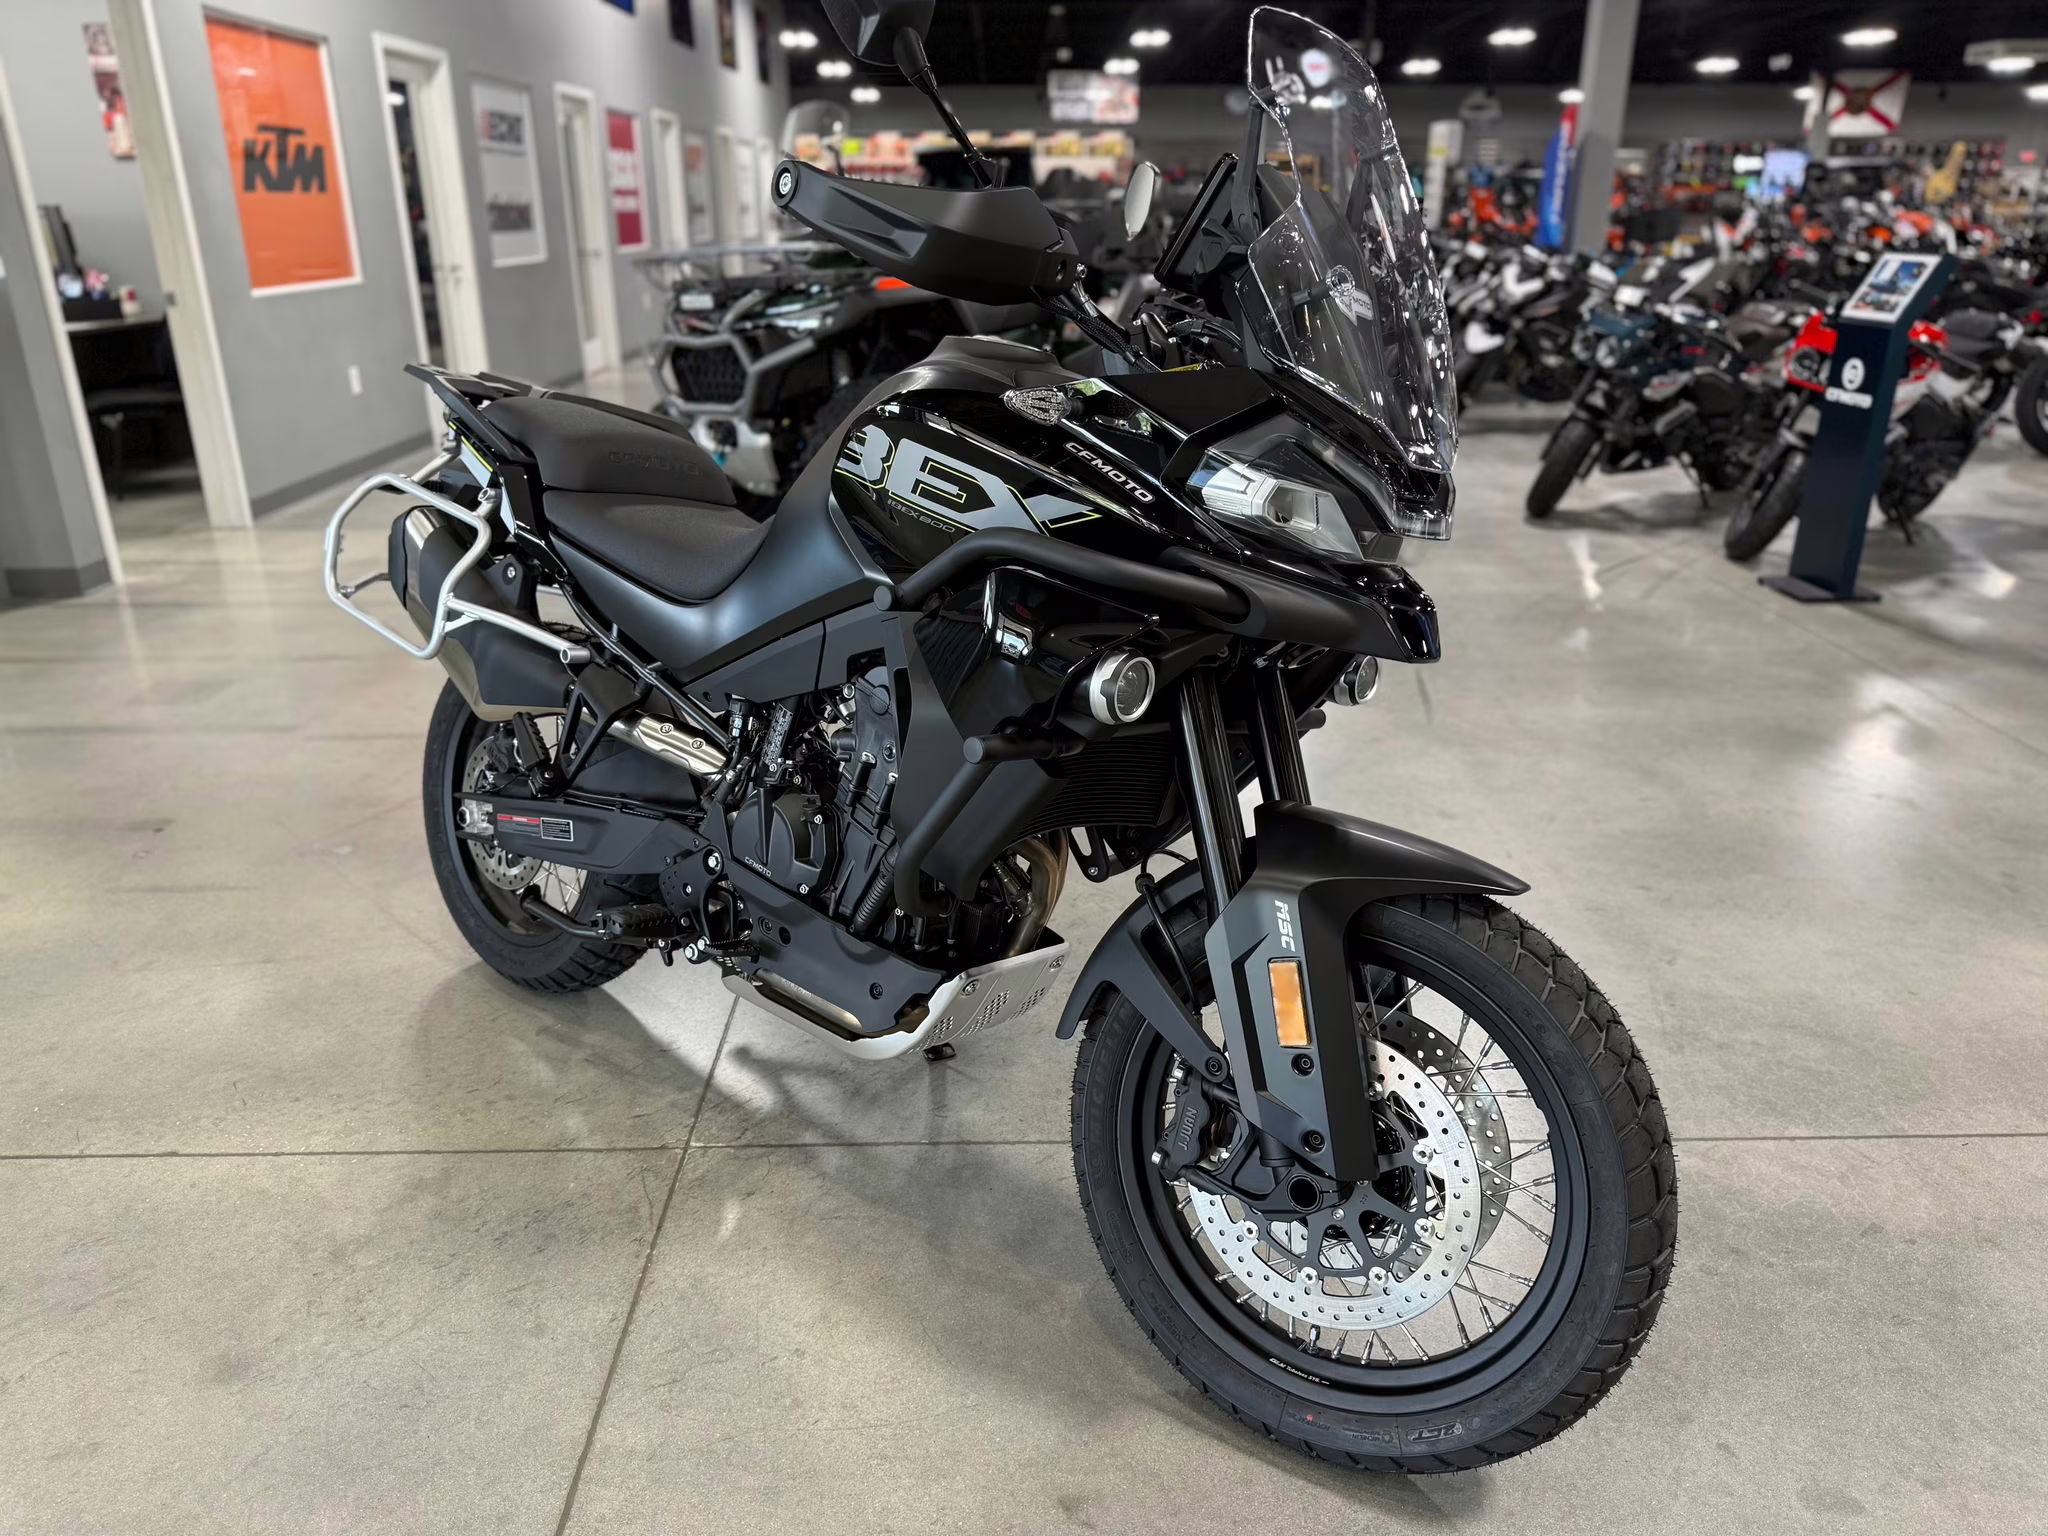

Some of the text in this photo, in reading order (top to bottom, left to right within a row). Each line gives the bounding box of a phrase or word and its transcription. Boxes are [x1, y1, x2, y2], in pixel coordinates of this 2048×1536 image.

[243, 123, 327, 194] KTM
[1065, 442, 1154, 502] CFMOTO
[887, 499, 956, 533] IBEX 800
[744, 856, 772, 877] CFMOTO
[1274, 899, 1296, 953] MSC
[1178, 1106, 1199, 1151] J.JUAN
